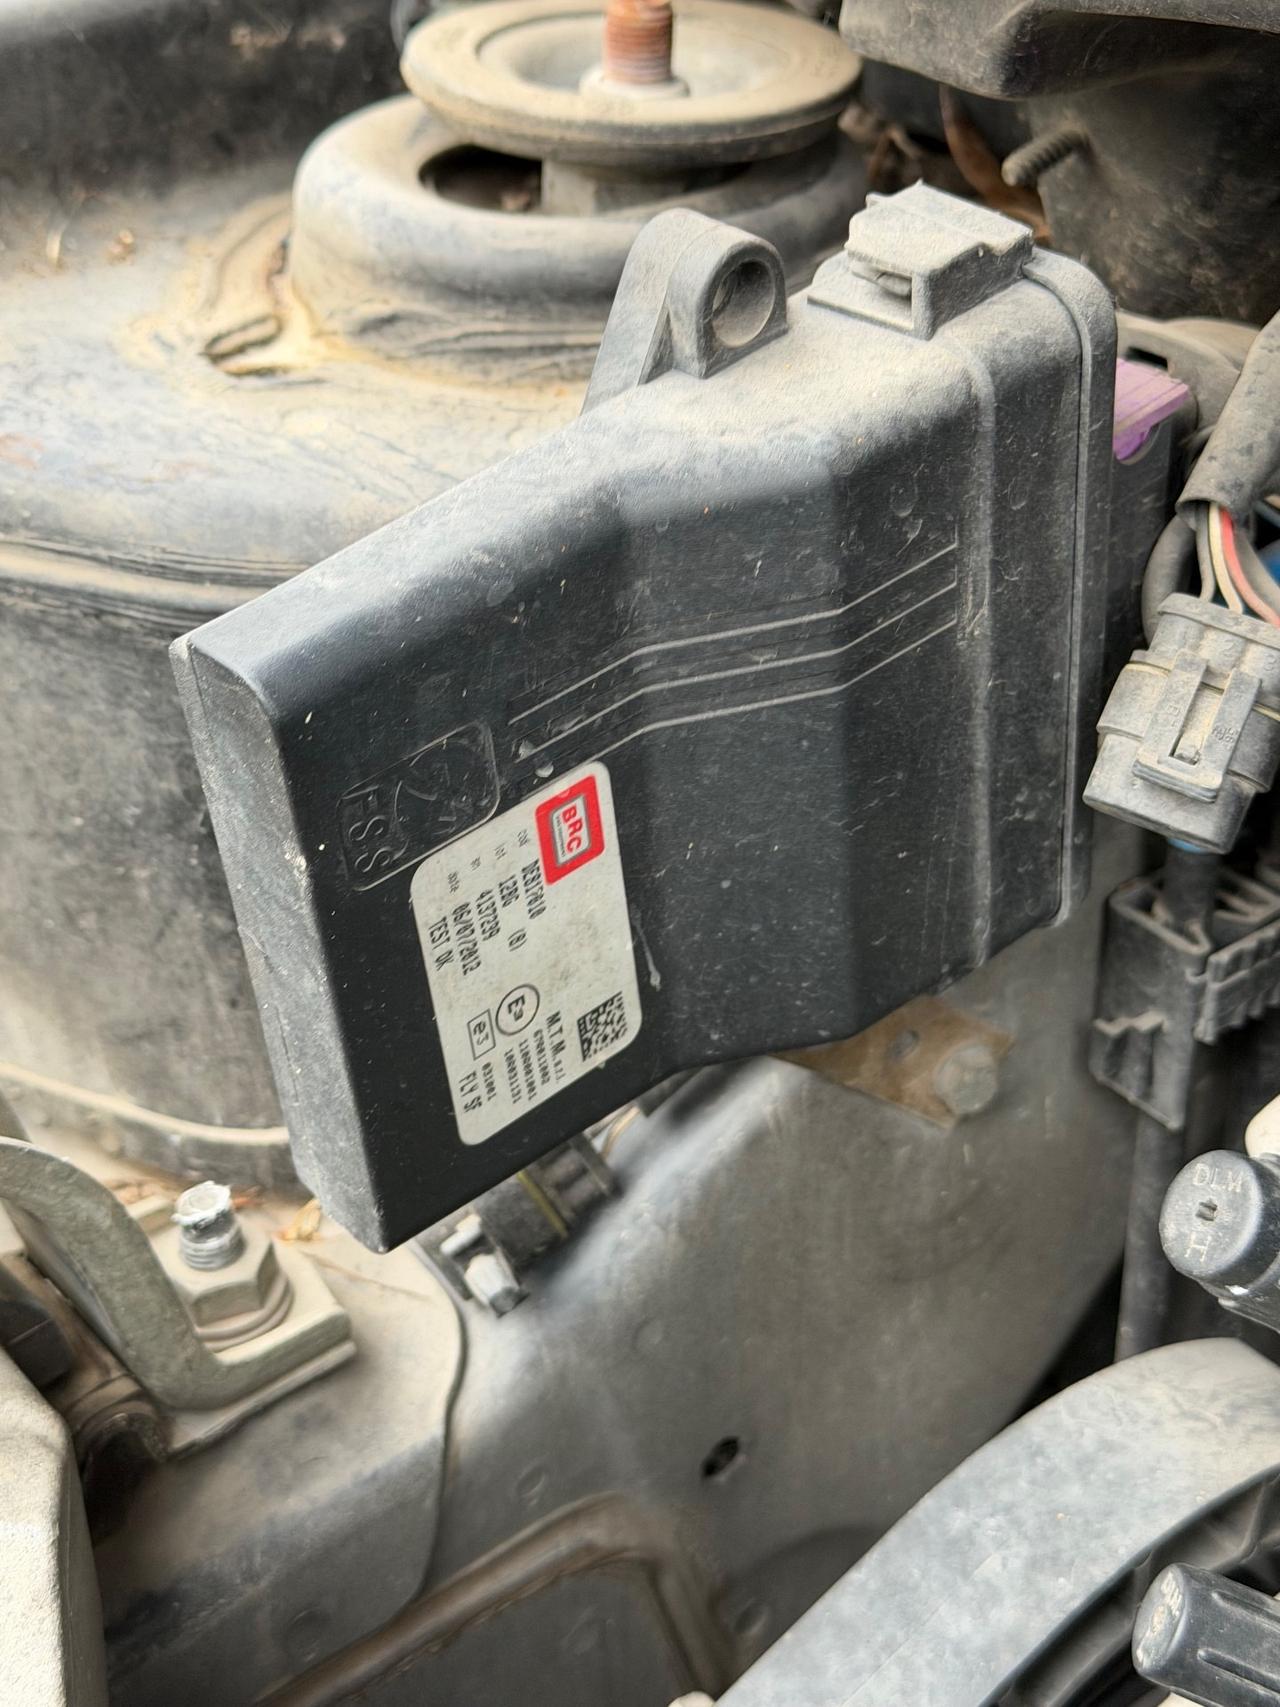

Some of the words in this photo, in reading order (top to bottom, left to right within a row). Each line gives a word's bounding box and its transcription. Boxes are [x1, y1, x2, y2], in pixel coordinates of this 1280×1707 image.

[562, 805, 583, 853] BRC
[476, 889, 501, 941] 4137239
[428, 916, 451, 949] TEST
[452, 902, 481, 976] 06/07/2012
[435, 949, 454, 971] OK
[473, 1021, 489, 1045] e3
[459, 1071, 478, 1097] FLY
[482, 1062, 496, 1101] 031001
[464, 1095, 482, 1112] SF
